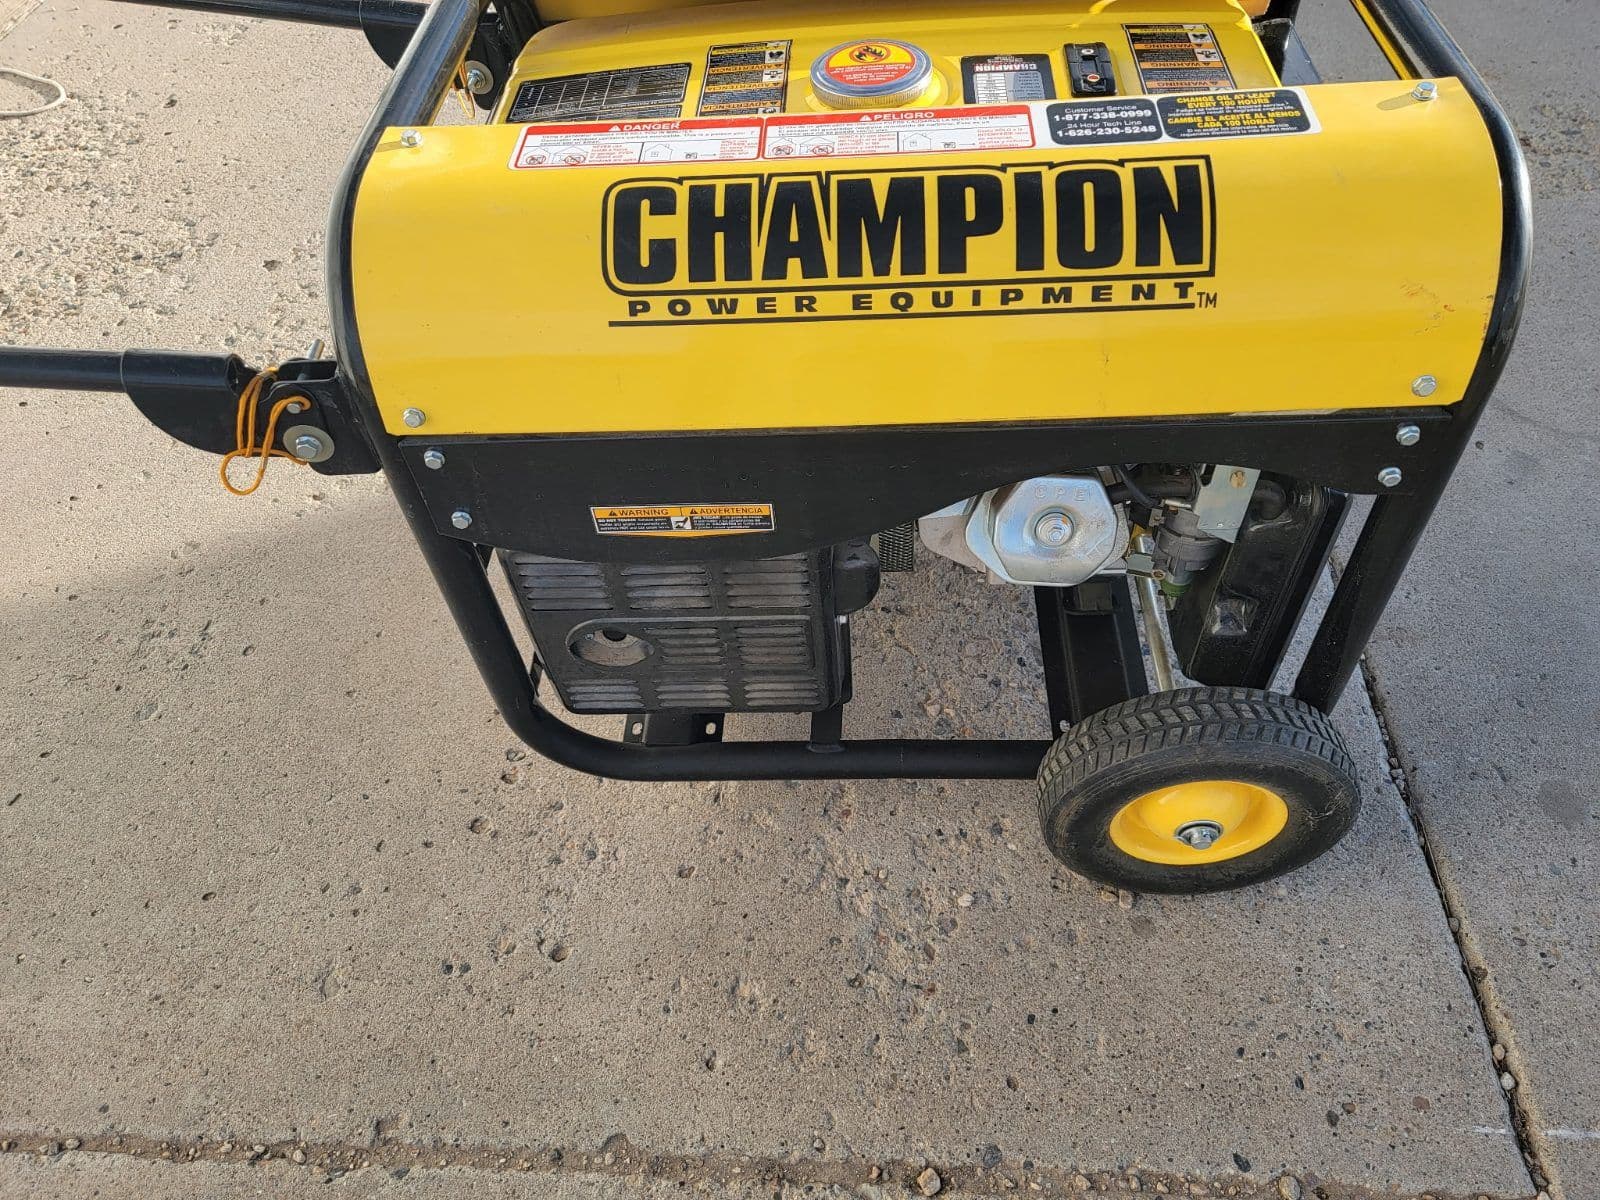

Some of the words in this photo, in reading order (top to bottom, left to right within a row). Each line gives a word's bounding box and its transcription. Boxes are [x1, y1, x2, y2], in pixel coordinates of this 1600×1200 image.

[974, 63, 1037, 72] CHAMPION
[1176, 95, 1215, 103] CHANGE
[703, 101, 768, 110] ADVERTENCIA
[874, 111, 935, 121] PELIGRO
[1053, 109, 1152, 122] 1-877-338-0999
[1167, 116, 1203, 124] CAMBIE
[1219, 113, 1251, 121] ACEITE
[1267, 110, 1301, 118] MENOS
[623, 122, 680, 131] DANGER
[1225, 119, 1241, 127] 100
[1242, 118, 1275, 126] HORAS
[1056, 125, 1157, 137] 1-626-230-5248
[613, 164, 1207, 286] CHAMPION
[628, 295, 818, 317] POWER
[851, 281, 1195, 313] EQUIPMENT
[618, 508, 669, 517] WARNING
[699, 507, 763, 515] ADVERTENCIA
